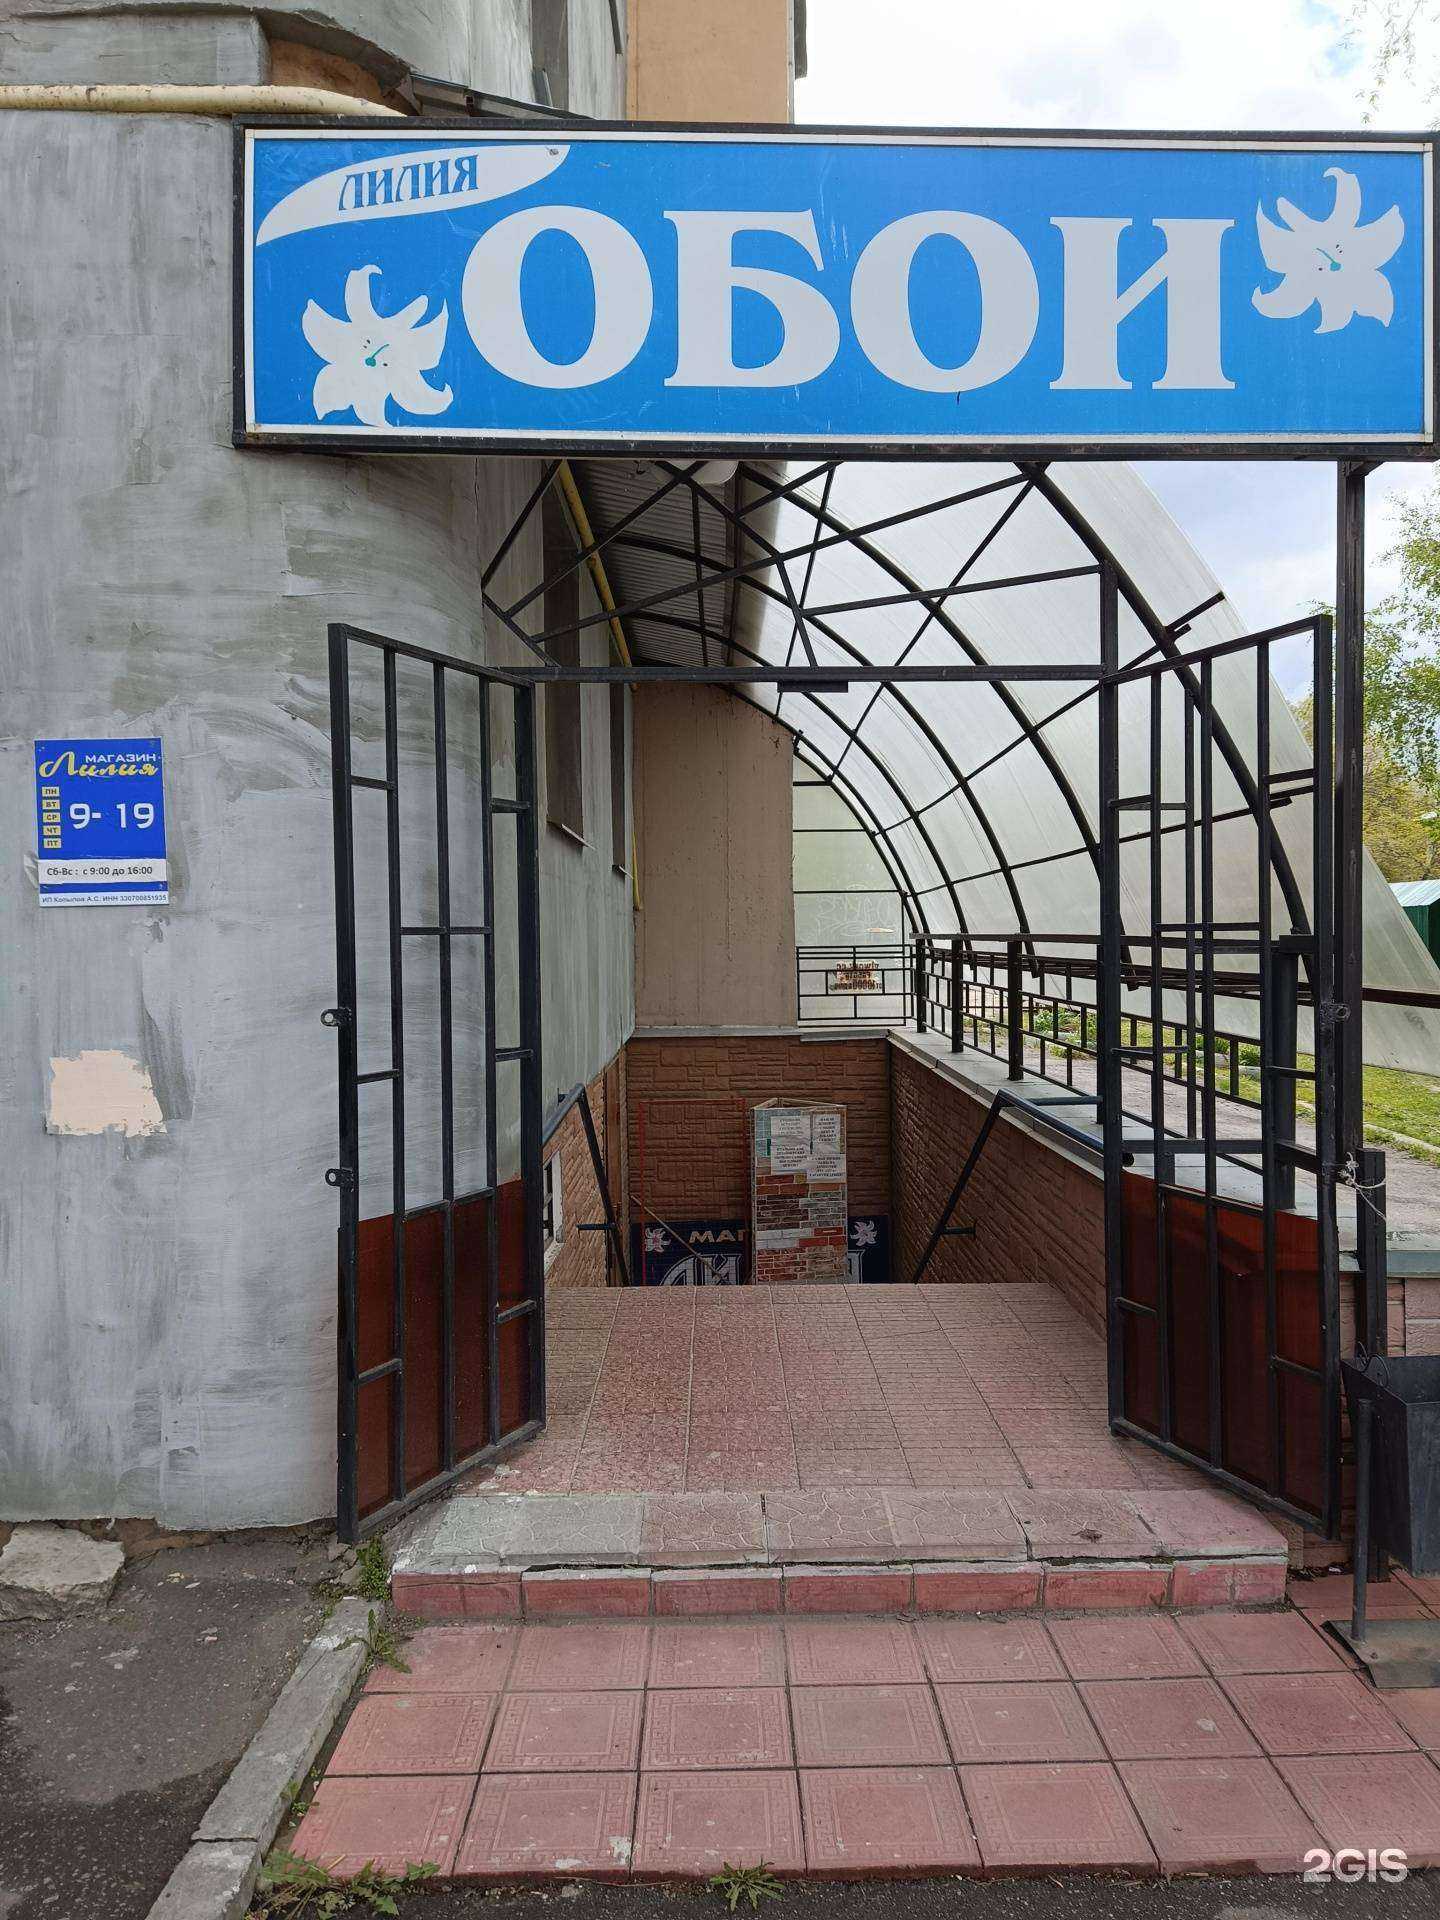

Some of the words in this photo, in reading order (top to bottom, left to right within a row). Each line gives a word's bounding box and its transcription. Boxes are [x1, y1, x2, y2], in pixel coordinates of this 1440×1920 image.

[337, 153, 479, 212] ЛИЛИЯ
[461, 204, 1236, 393] ОБОИ
[39, 751, 159, 778] Лилия
[85, 753, 156, 764] МАГАЗИН
[116, 802, 155, 829] 19
[89, 867, 110, 875] 9:00
[112, 868, 125, 876] до
[127, 866, 153, 875] 16:00
